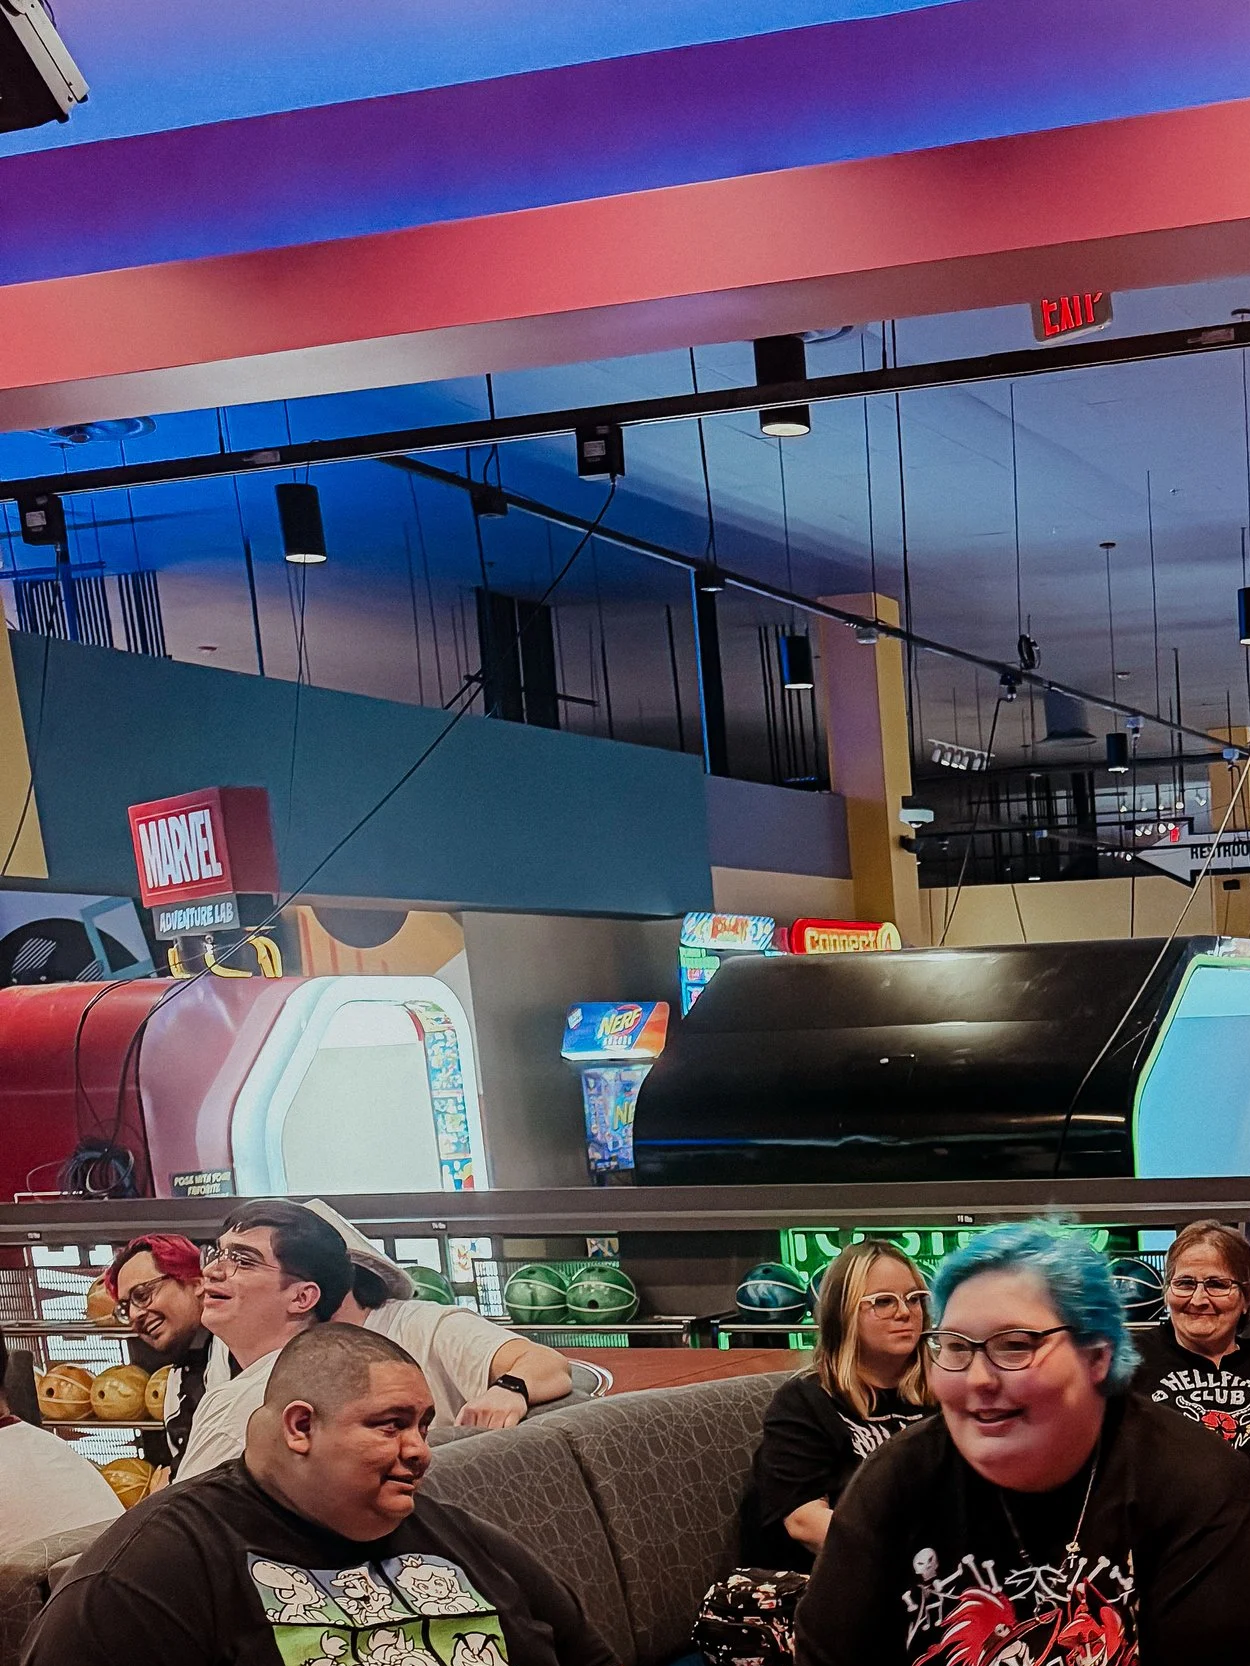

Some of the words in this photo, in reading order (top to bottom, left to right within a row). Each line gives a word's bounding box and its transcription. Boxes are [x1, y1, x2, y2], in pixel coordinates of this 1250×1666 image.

[138, 809, 223, 889] MARVEL
[159, 904, 213, 933] ADVENTURE
[214, 902, 234, 924] LAB
[597, 1008, 642, 1039] NERF
[1190, 1388, 1246, 1406] CLUB
